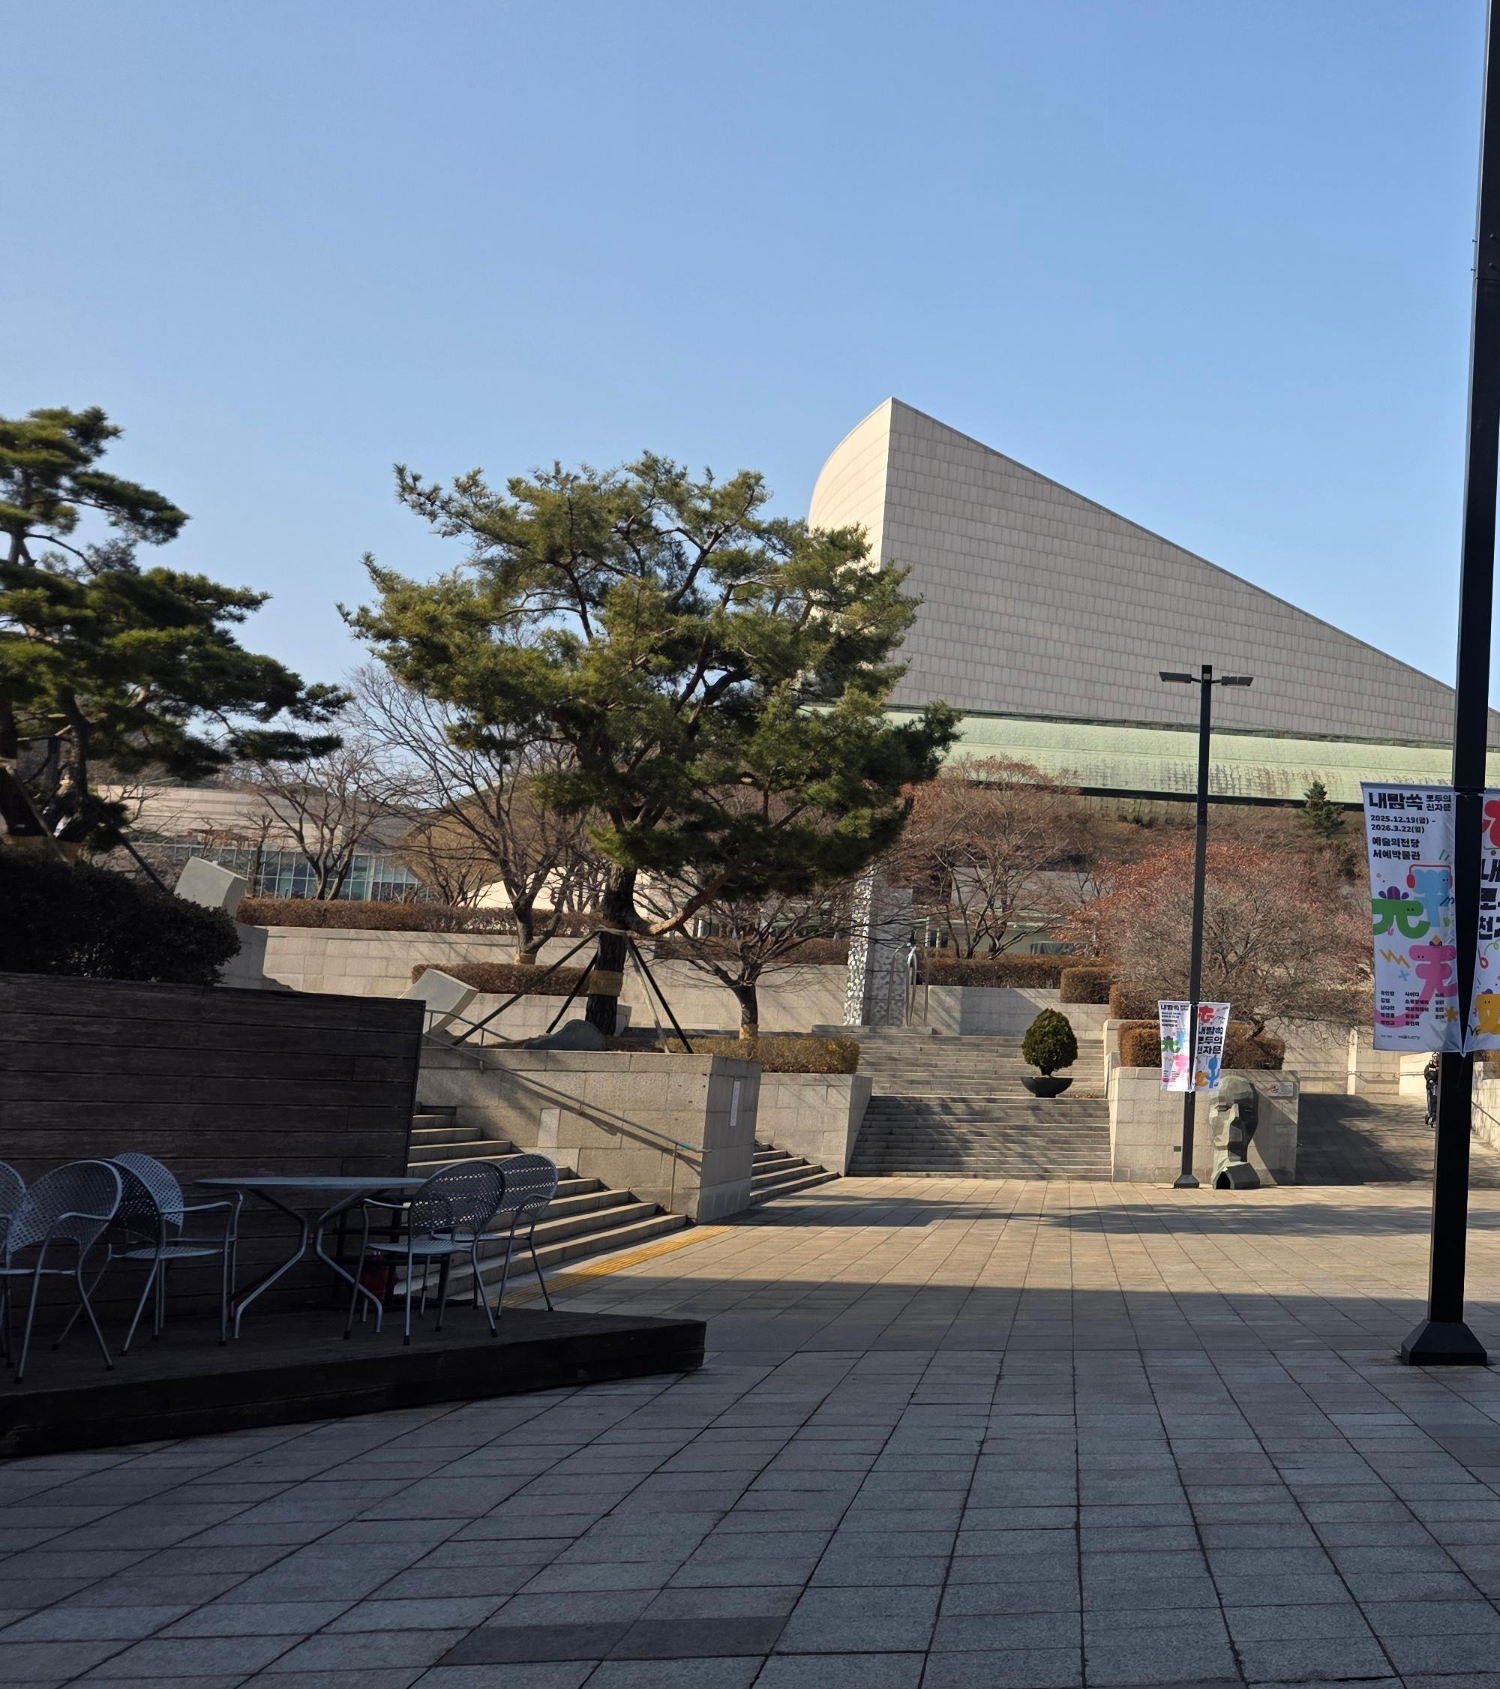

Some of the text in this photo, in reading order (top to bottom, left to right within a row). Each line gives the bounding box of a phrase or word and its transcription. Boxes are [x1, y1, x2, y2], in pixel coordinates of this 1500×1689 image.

[1368, 792, 1424, 811] 내맘쏙
[1426, 794, 1452, 803] 모두의
[1426, 803, 1452, 812] 천자문
[1370, 823, 1425, 834] 2026.3.22(일)
[1371, 836, 1420, 848] 예술의전당
[1372, 849, 1421, 861] 서예박물관
